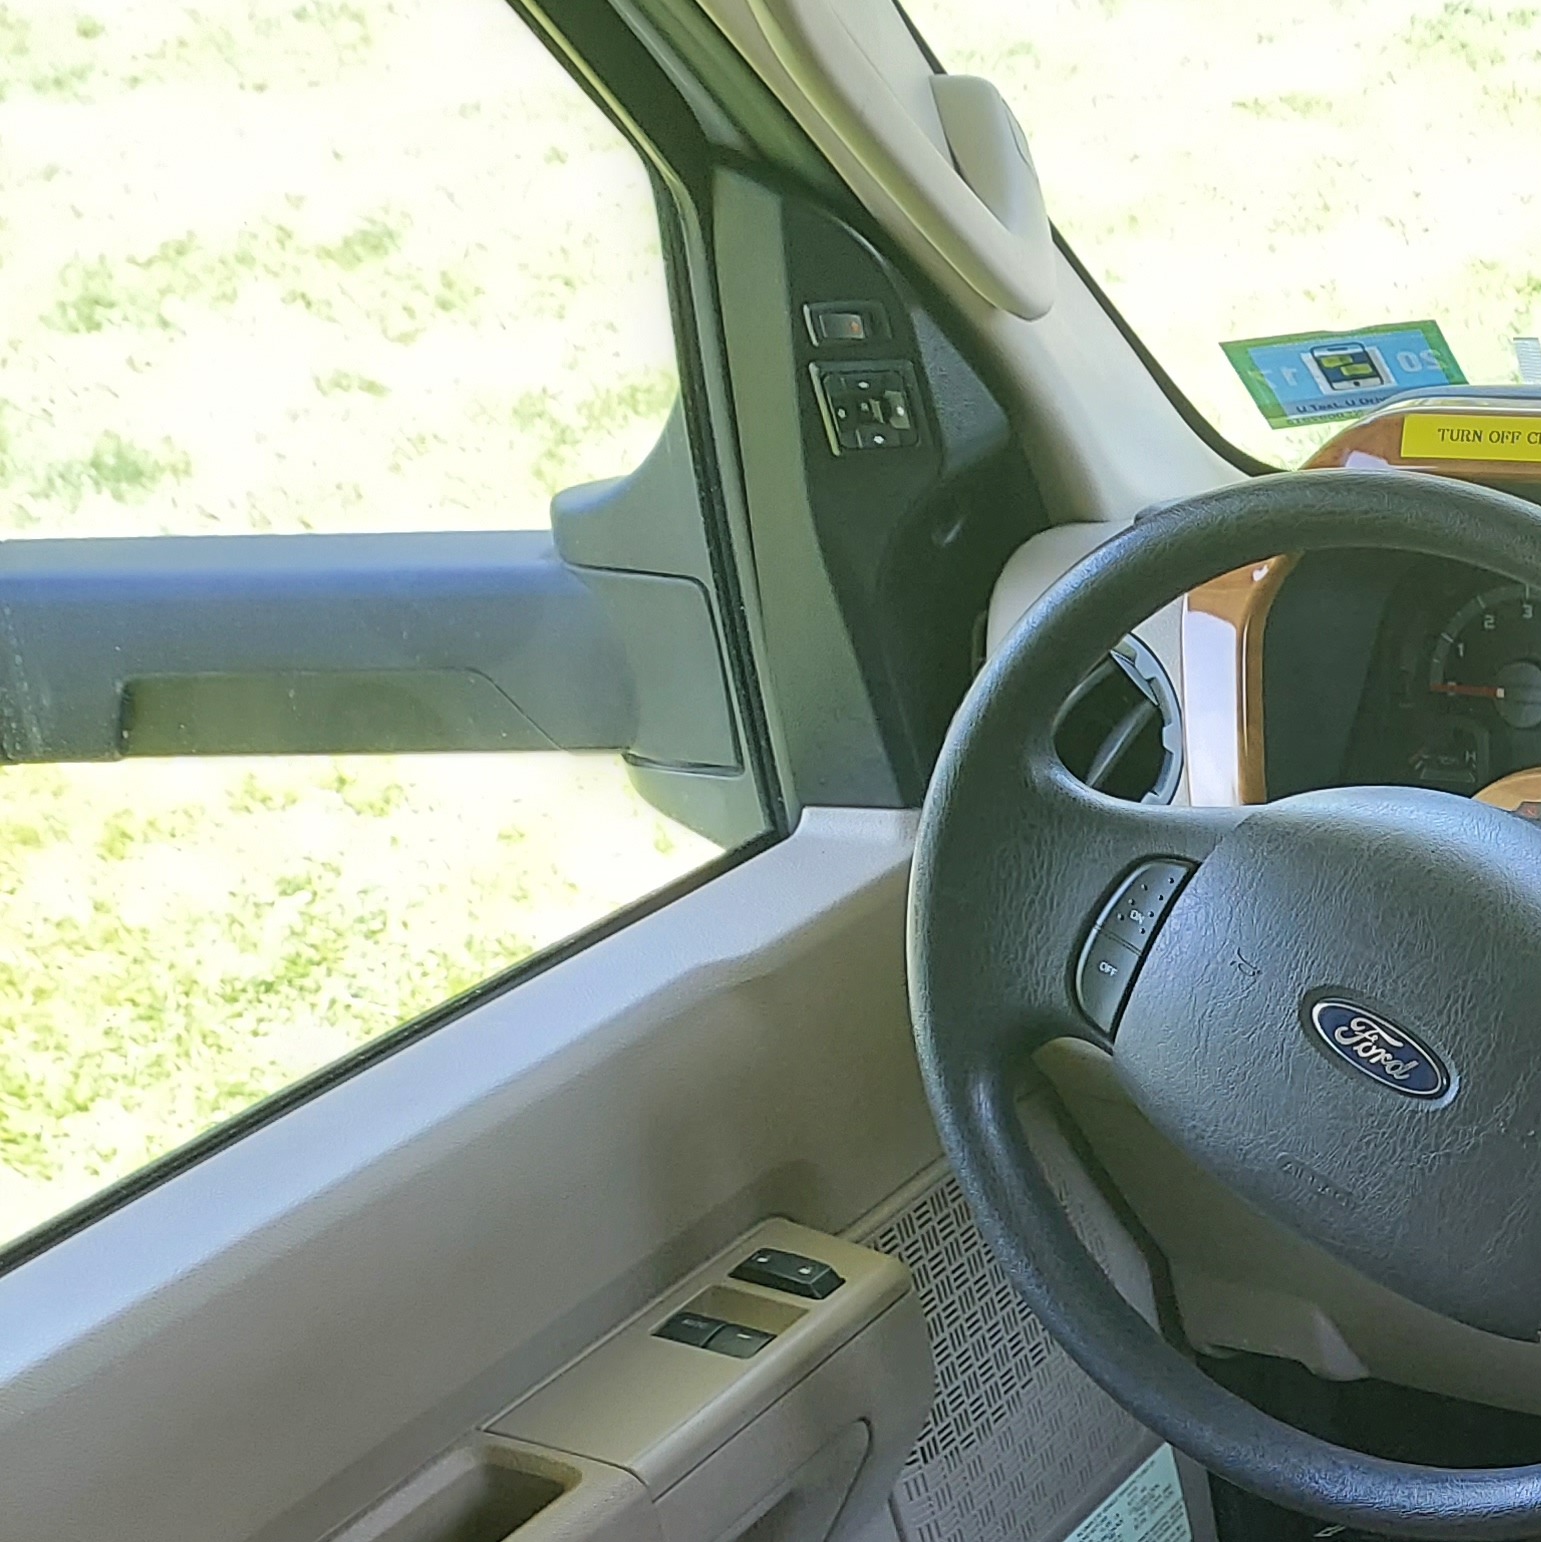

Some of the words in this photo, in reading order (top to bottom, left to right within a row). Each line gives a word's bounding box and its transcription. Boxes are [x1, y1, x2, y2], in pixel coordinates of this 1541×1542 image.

[1438, 429, 1483, 442] TURN
[1489, 431, 1521, 444] OFF
[1523, 604, 1533, 619] 3
[1484, 615, 1495, 630] 2
[1457, 643, 1465, 657] 1
[1100, 961, 1118, 976] OFF
[1335, 1017, 1419, 1080] Ford
